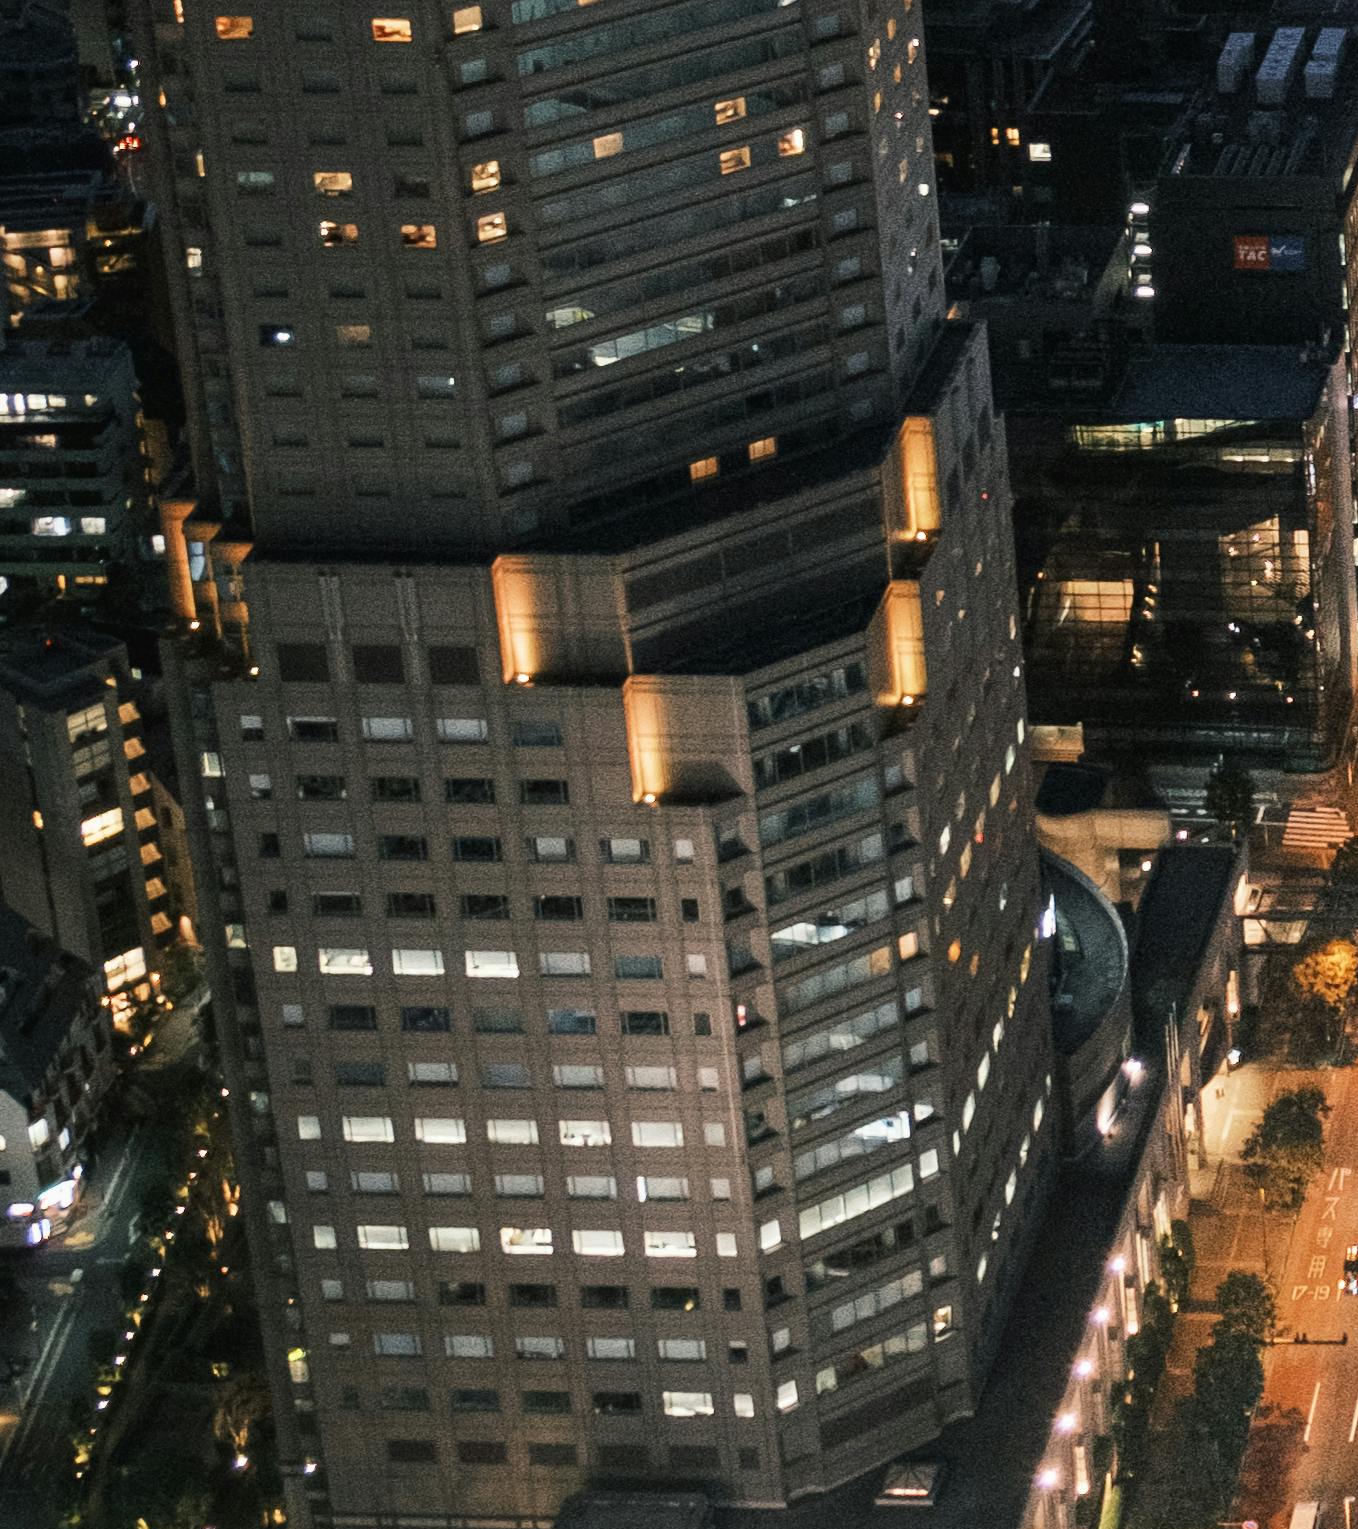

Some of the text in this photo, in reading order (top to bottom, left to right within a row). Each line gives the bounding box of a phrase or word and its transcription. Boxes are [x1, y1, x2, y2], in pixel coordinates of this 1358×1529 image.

[1307, 1167, 1351, 1279] バス専用
[1291, 1285, 1330, 1301] 17-19
